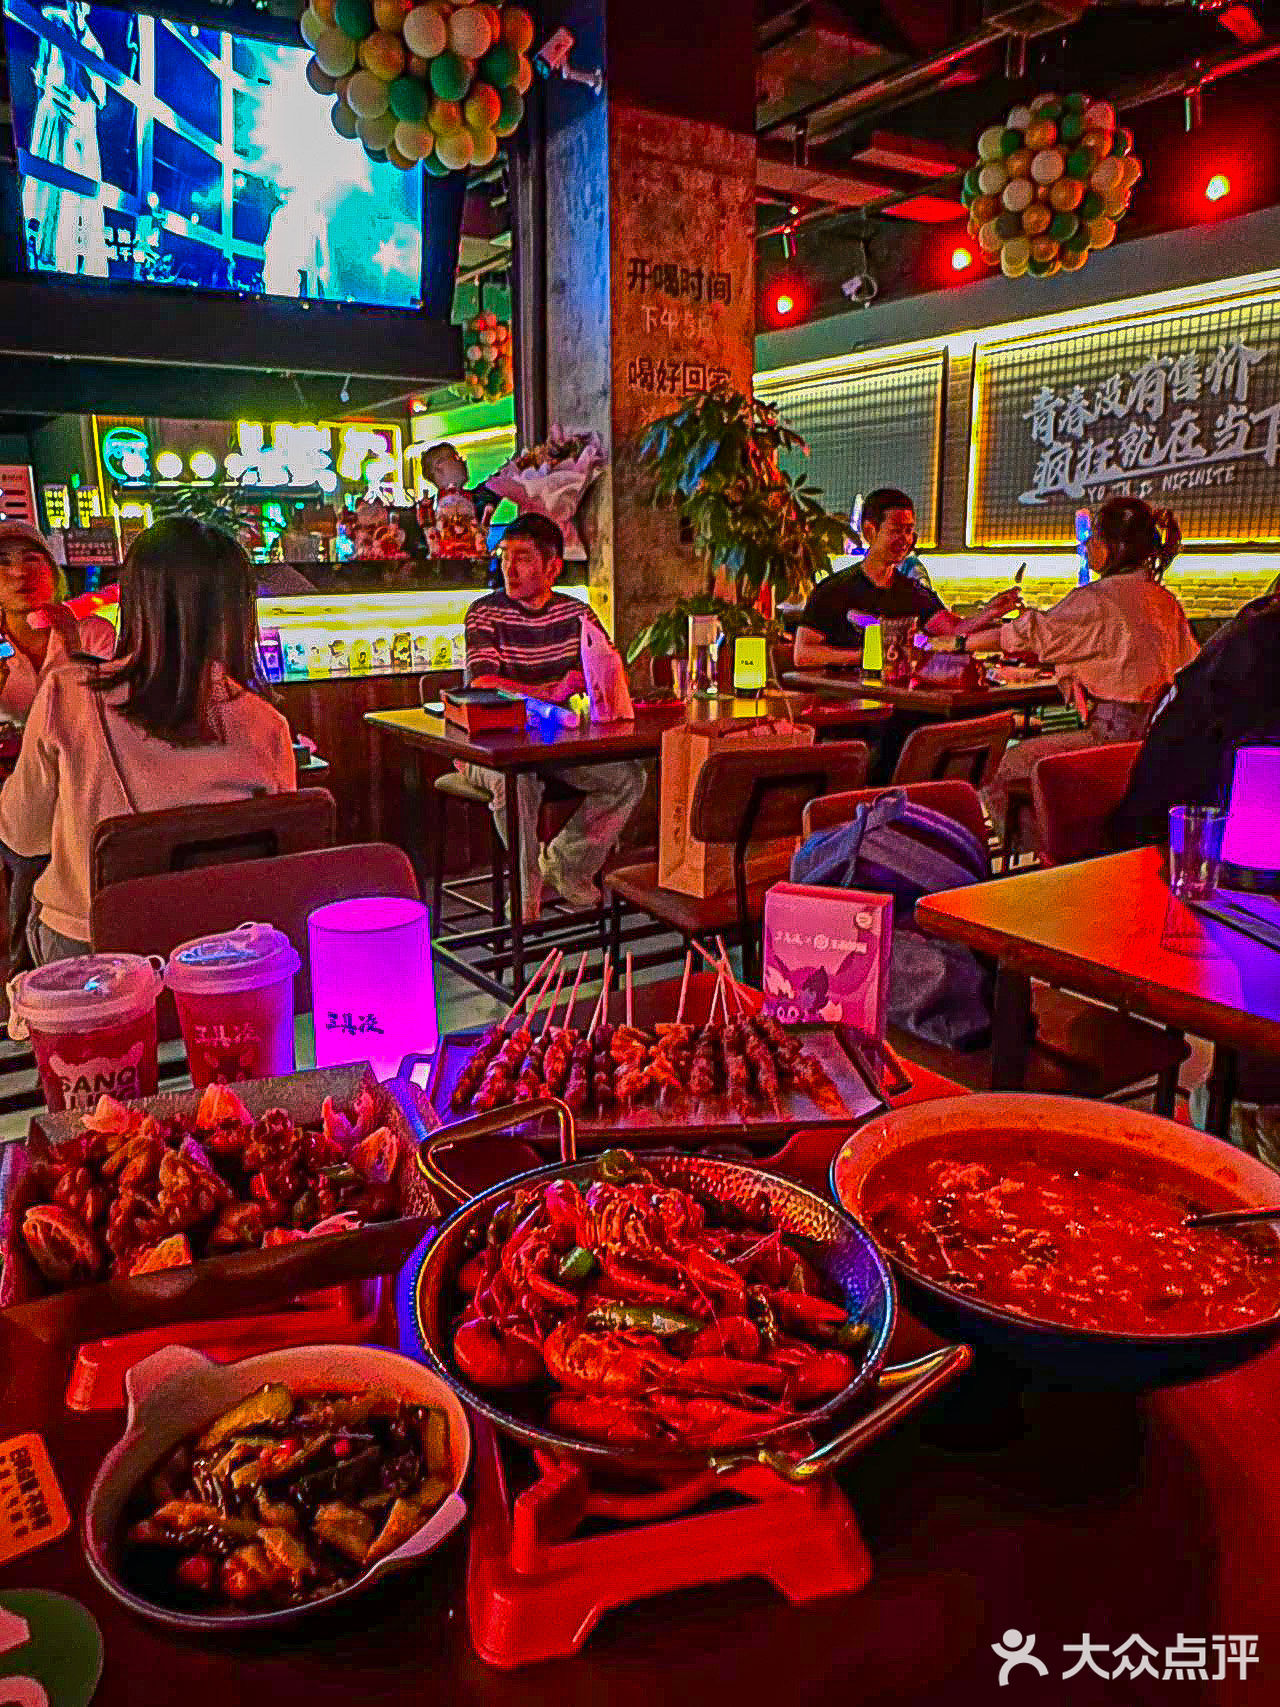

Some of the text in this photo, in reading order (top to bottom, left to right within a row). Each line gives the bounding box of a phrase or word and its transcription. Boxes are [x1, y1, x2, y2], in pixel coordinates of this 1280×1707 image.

[626, 257, 732, 306] 开喝时间
[1023, 336, 1267, 447] 青春没有售价
[1018, 402, 1280, 504] 疯狂就在当下
